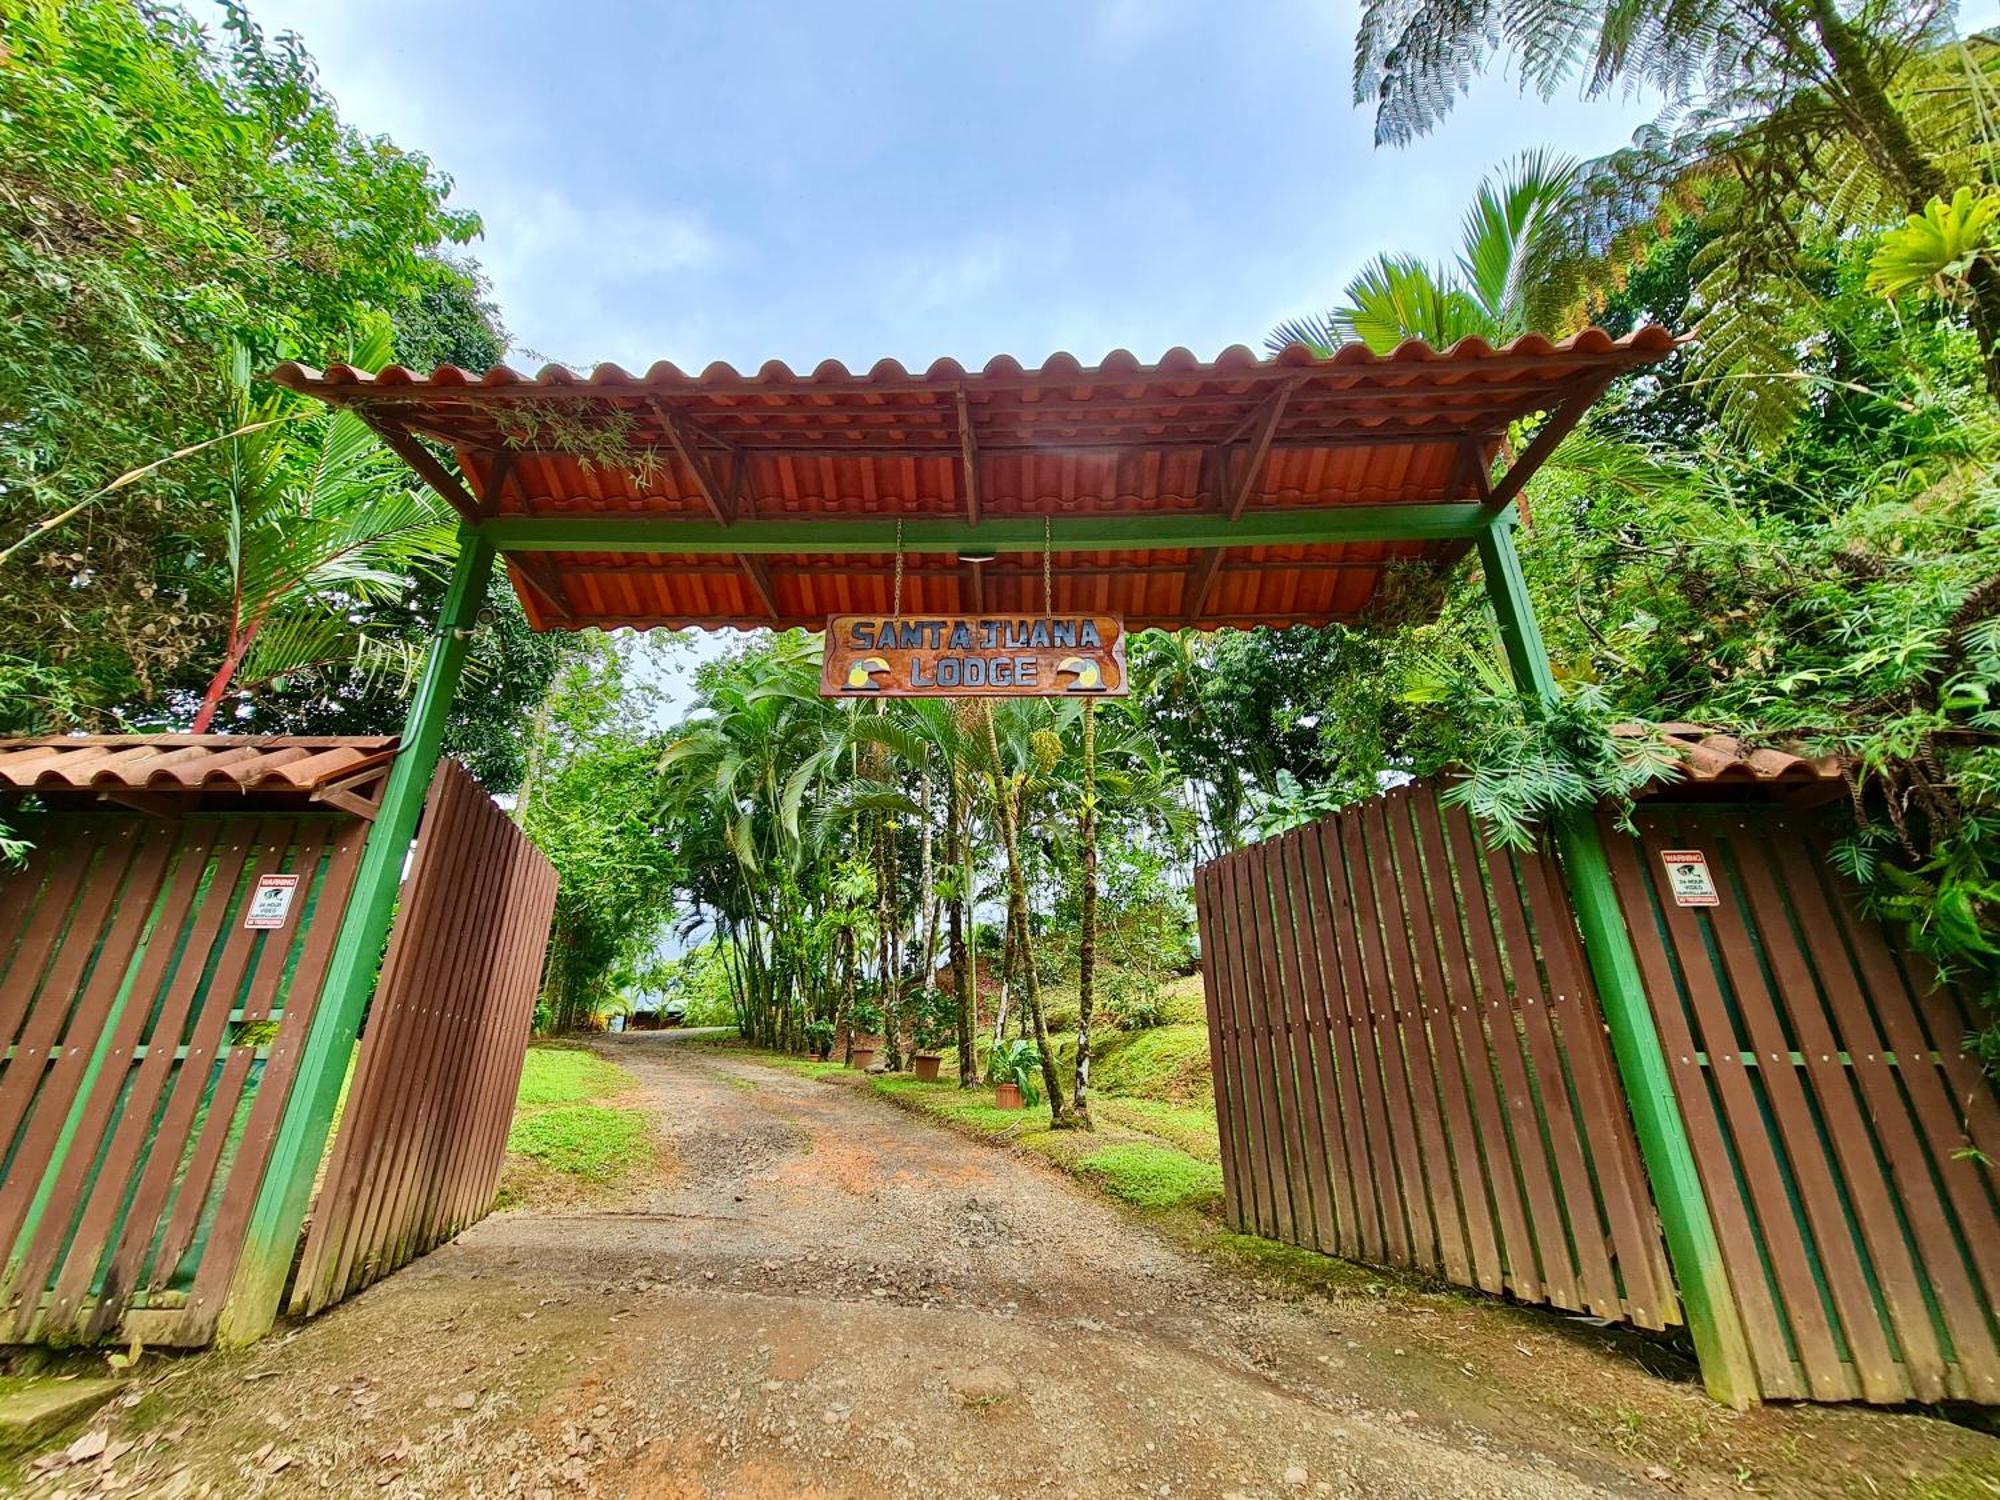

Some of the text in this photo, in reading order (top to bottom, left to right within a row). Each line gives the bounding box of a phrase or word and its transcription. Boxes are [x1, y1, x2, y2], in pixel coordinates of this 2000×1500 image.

[851, 619, 1101, 649] SANTA JUANA
[910, 656, 1038, 688] LODGE
[1664, 854, 1702, 862] WARNING
[262, 878, 295, 886] WARNING
